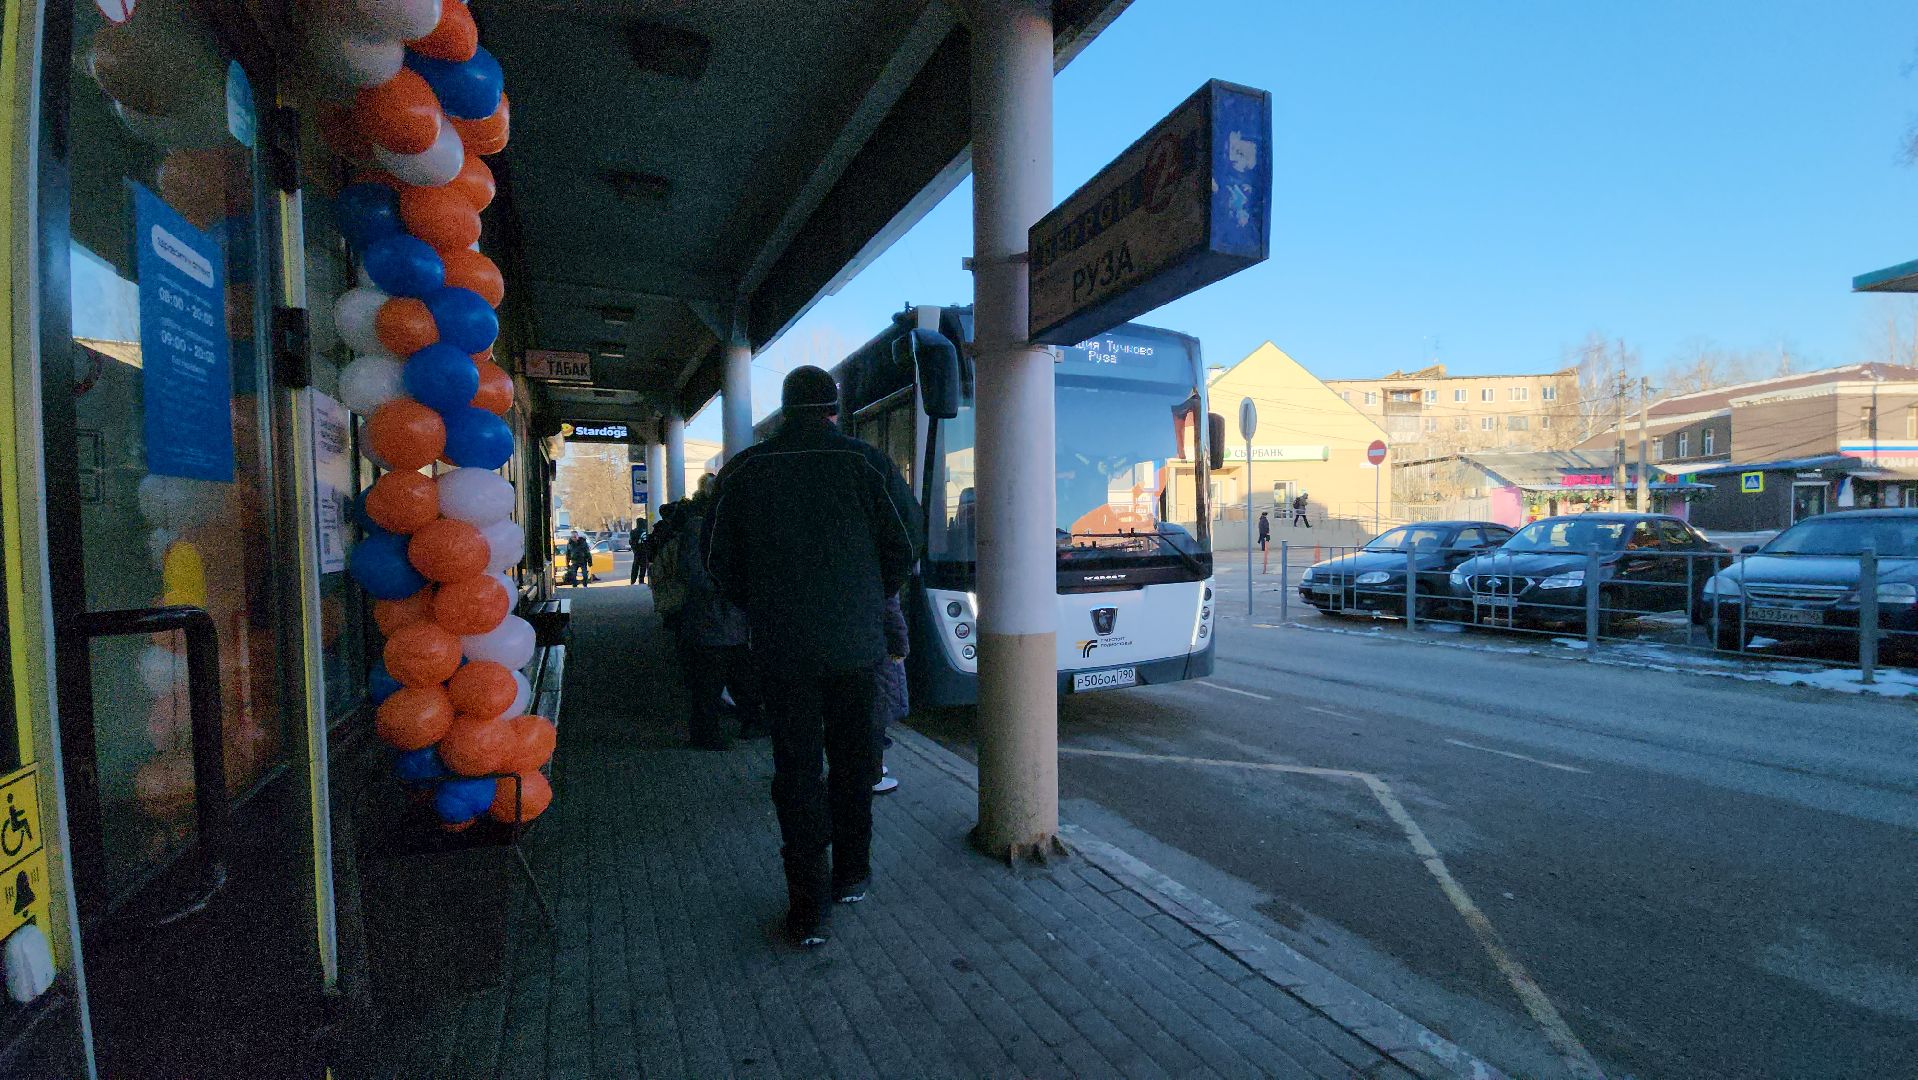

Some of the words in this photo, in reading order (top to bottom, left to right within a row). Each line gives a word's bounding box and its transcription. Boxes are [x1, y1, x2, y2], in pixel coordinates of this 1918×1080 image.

[1073, 240, 1133, 303] РУЗА
[1075, 340, 1100, 350] ция
[1106, 340, 1153, 356] Тучково
[1088, 350, 1117, 364] Руза
[547, 360, 589, 376] ТАБАК
[576, 426, 628, 438] Stardogs
[1234, 448, 1284, 457] СБРБАНК
[1118, 669, 1134, 681] 790
